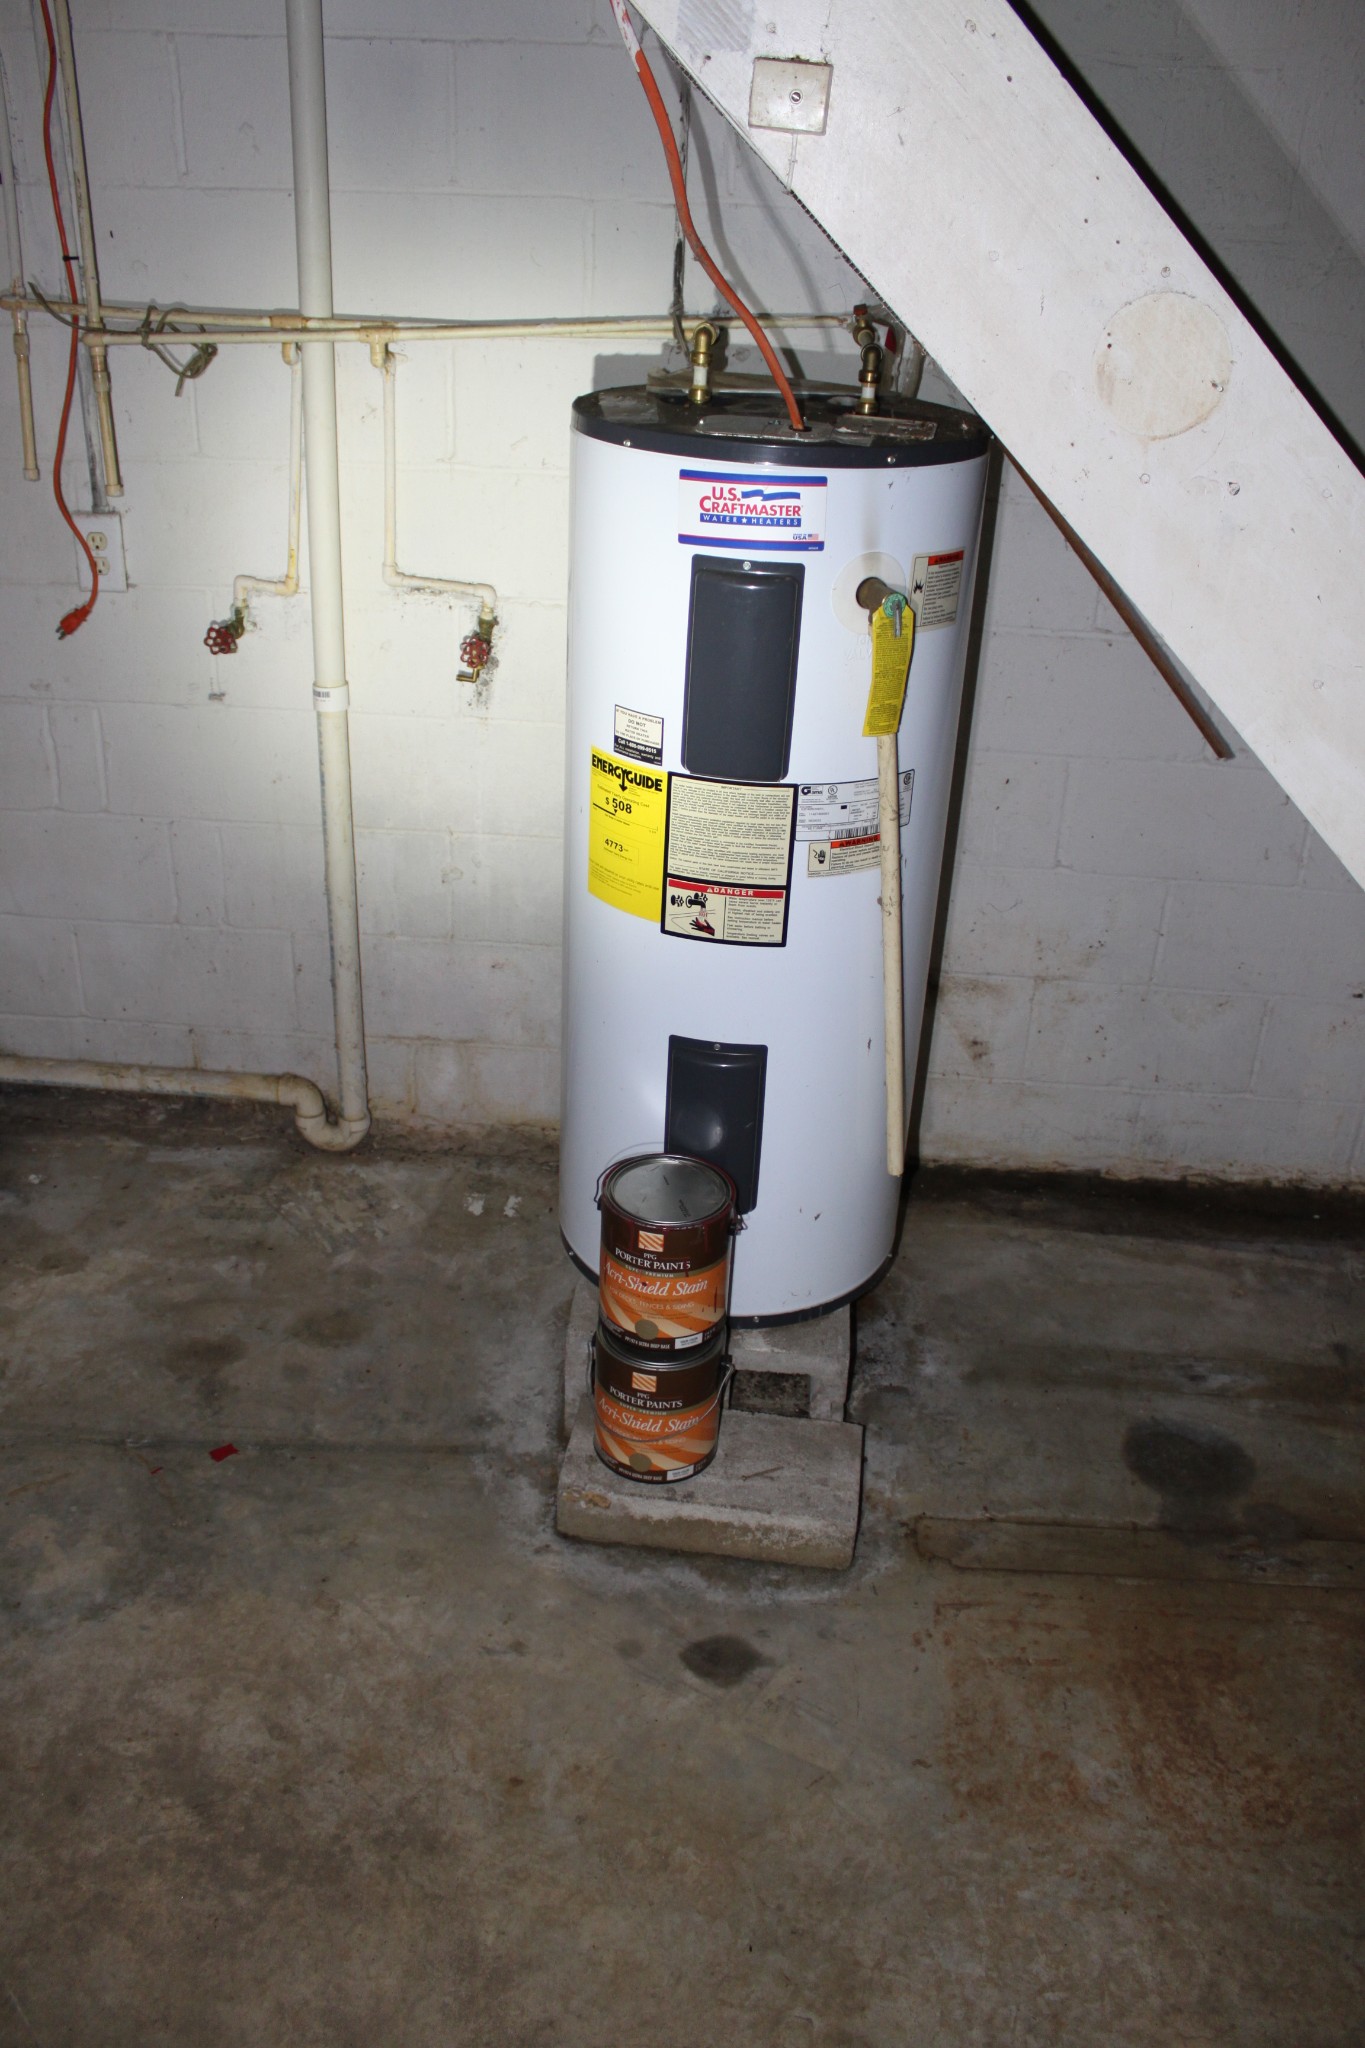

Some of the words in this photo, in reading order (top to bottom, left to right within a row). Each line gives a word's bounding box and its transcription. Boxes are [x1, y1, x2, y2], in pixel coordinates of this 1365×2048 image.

[712, 486, 741, 501] U.S.
[699, 496, 801, 517] CRAFTMASTER
[703, 514, 738, 523] WATER
[751, 518, 798, 526] HEATERS
[612, 798, 632, 814] 508
[605, 838, 623, 852] 4773
[714, 888, 754, 896] DANGER
[615, 1247, 651, 1269] PORTER
[653, 1261, 691, 1270] PAINTS
[643, 1252, 657, 1260] PPG
[604, 1261, 670, 1296] Acri-Shield
[672, 1278, 708, 1296] Stain
[609, 1386, 644, 1406] PORTER
[646, 1399, 683, 1408] PAINTS
[599, 1397, 662, 1432] Acri-Shield
[665, 1415, 700, 1432] Stain
